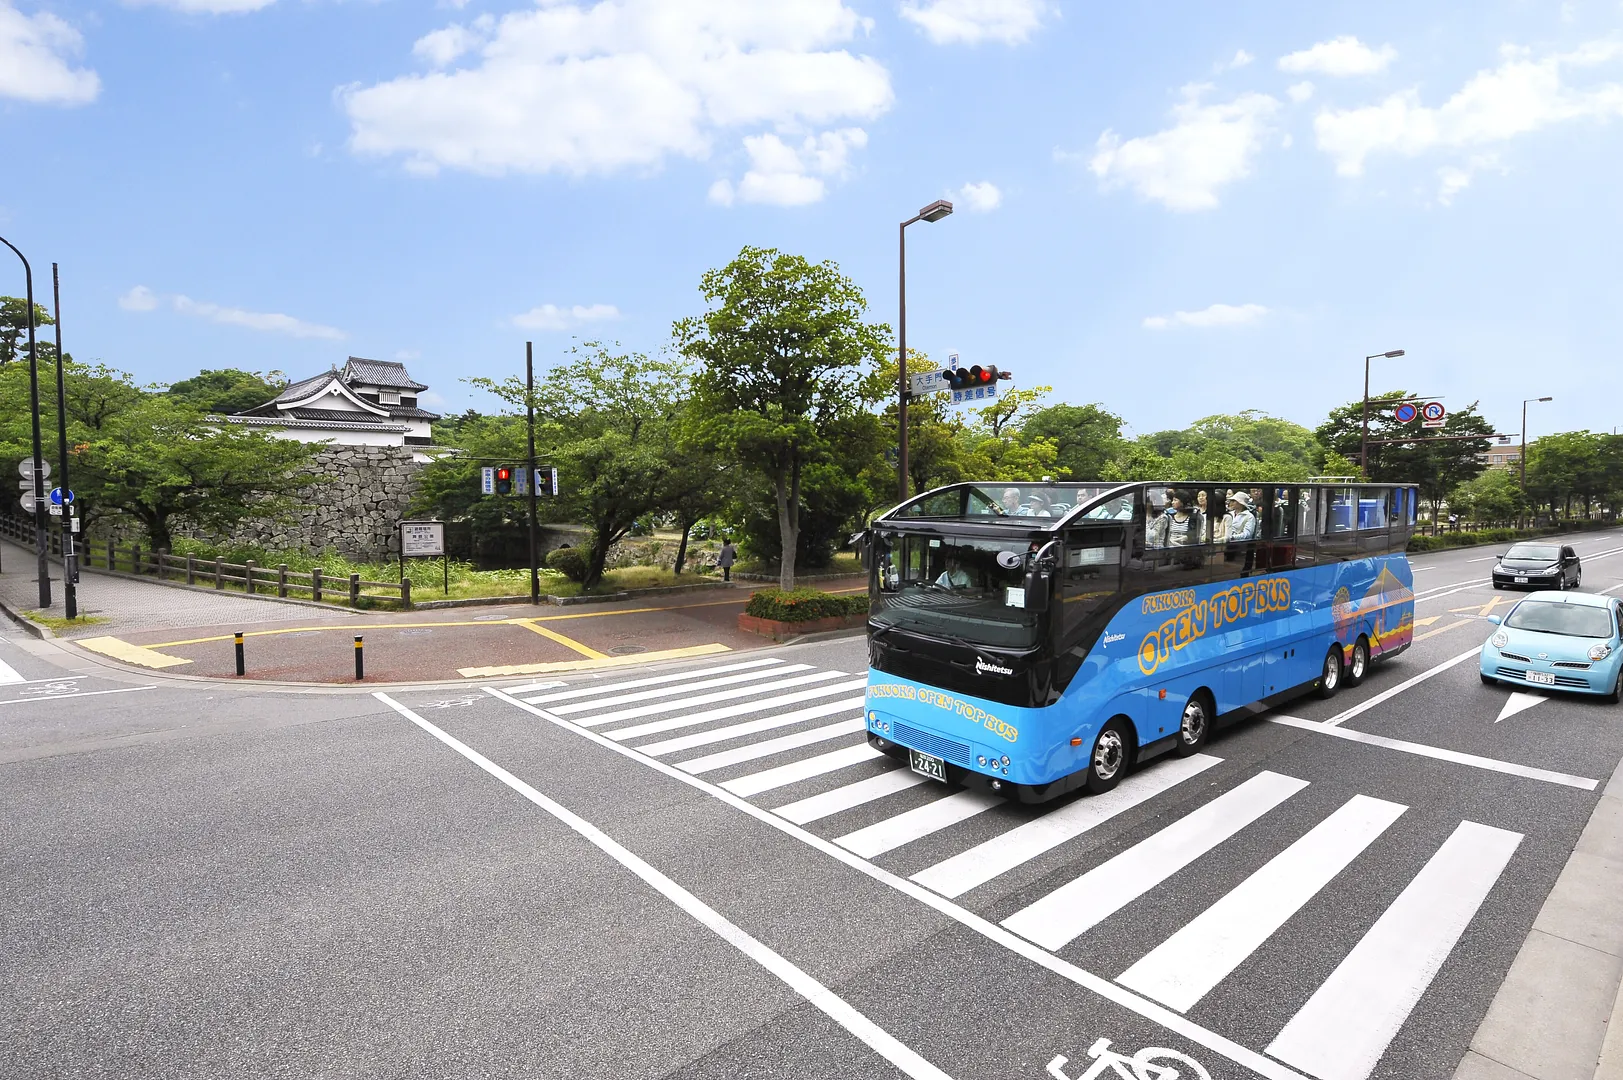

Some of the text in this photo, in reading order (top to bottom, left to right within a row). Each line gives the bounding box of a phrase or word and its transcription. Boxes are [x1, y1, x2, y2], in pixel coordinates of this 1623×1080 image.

[916, 371, 943, 386] 大手門
[954, 387, 996, 401] 時差信号
[1142, 589, 1196, 614] FUKUOKA
[1138, 578, 1291, 675] OPEN TOP BUS
[975, 655, 1013, 675] Nishitetsu
[868, 684, 1019, 743] FUKUOKA OPEN TOP BUS
